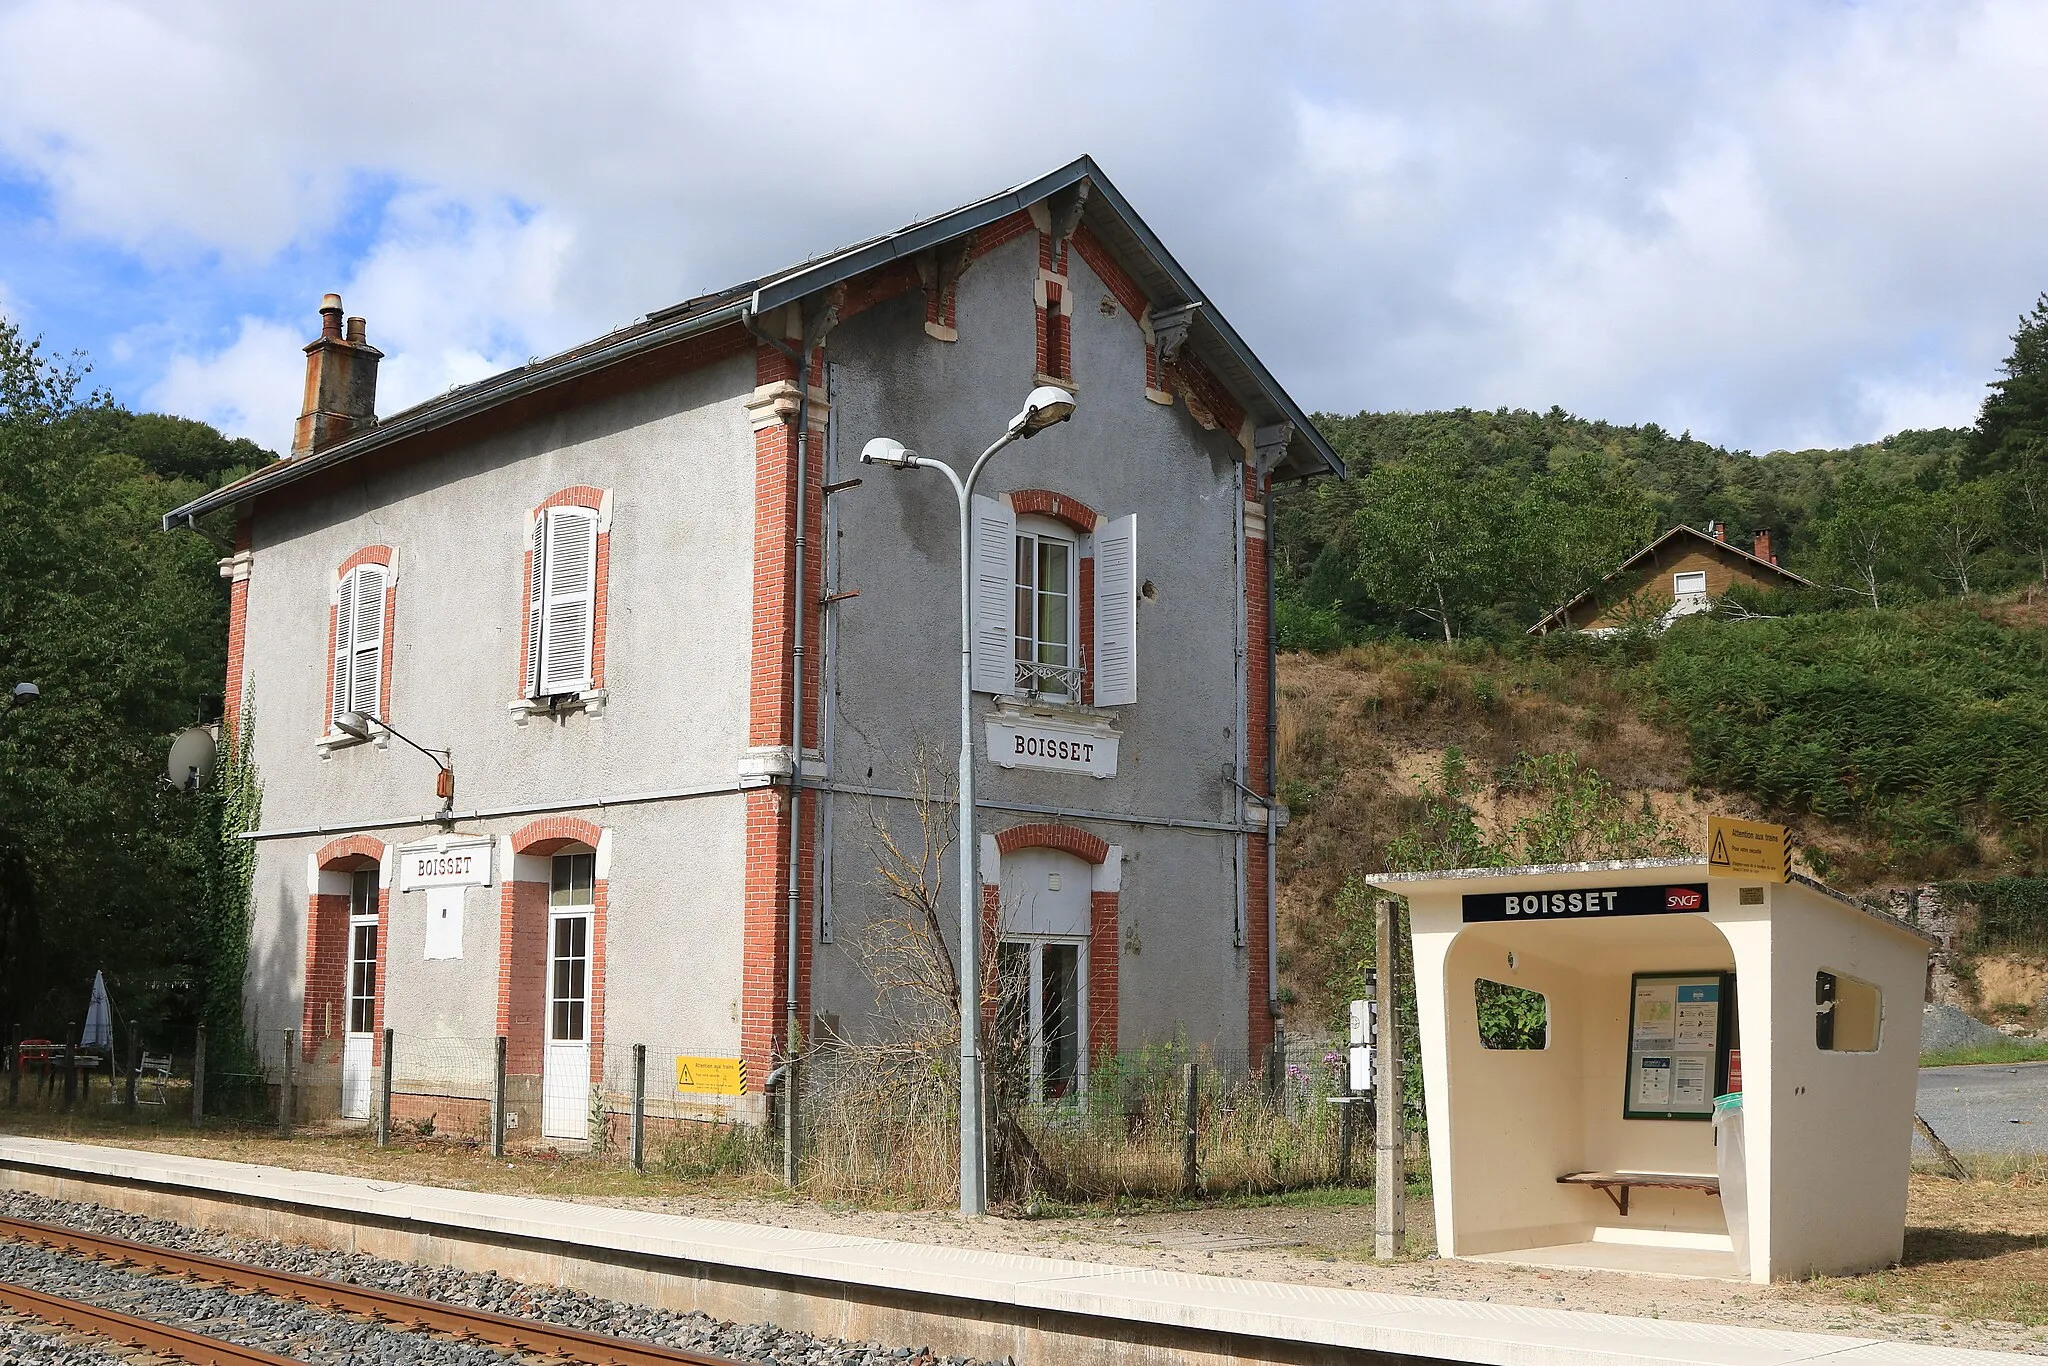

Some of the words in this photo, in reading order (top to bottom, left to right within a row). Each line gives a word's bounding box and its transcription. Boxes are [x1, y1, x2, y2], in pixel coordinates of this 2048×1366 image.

[1014, 735, 1094, 762] BOISSET
[1731, 829, 1754, 839] Attention
[1765, 834, 1779, 842] trains
[418, 857, 472, 876] BOISSET
[1505, 891, 1618, 915] BOISSET
[1667, 894, 1700, 908] SNCF
